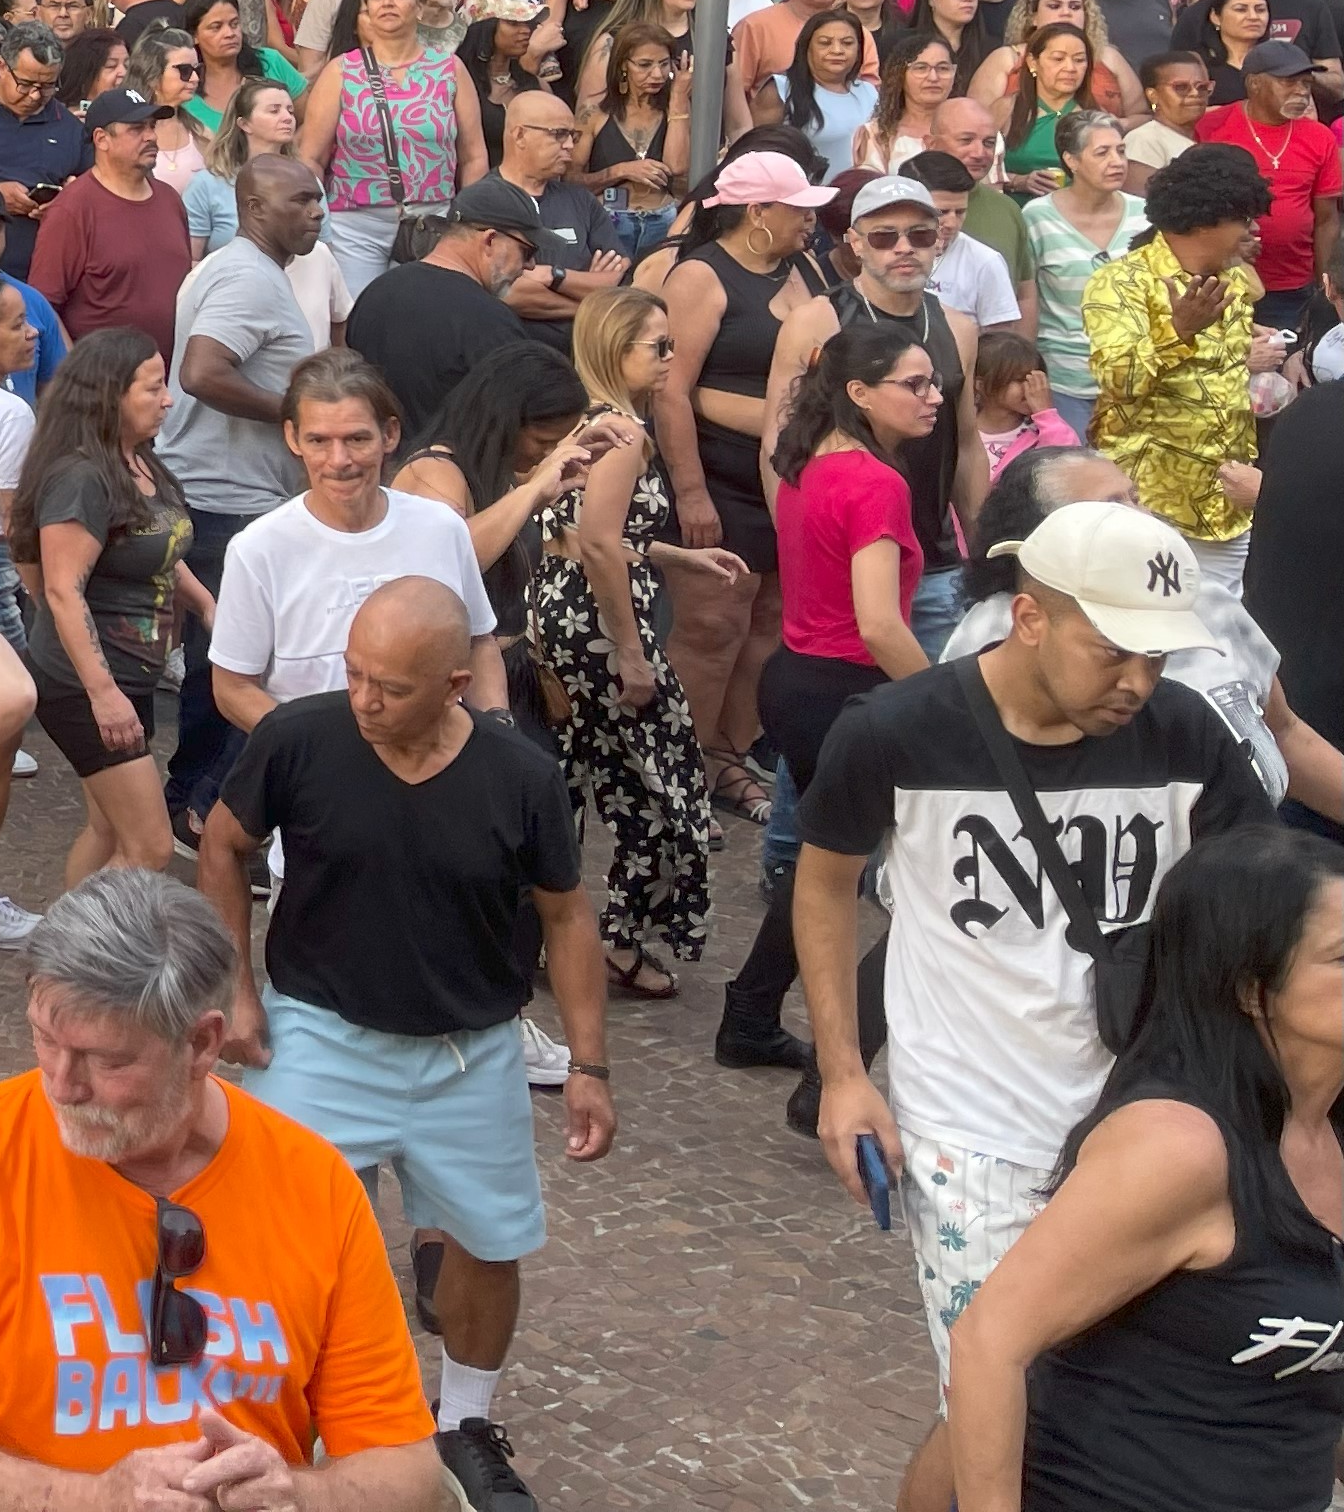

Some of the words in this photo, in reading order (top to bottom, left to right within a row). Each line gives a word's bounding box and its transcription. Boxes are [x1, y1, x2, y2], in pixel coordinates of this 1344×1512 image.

[368, 74, 387, 105] LOVE
[1146, 550, 1182, 597] NY
[40, 1273, 289, 1366] FLSH
[54, 1356, 215, 1436] BACK
